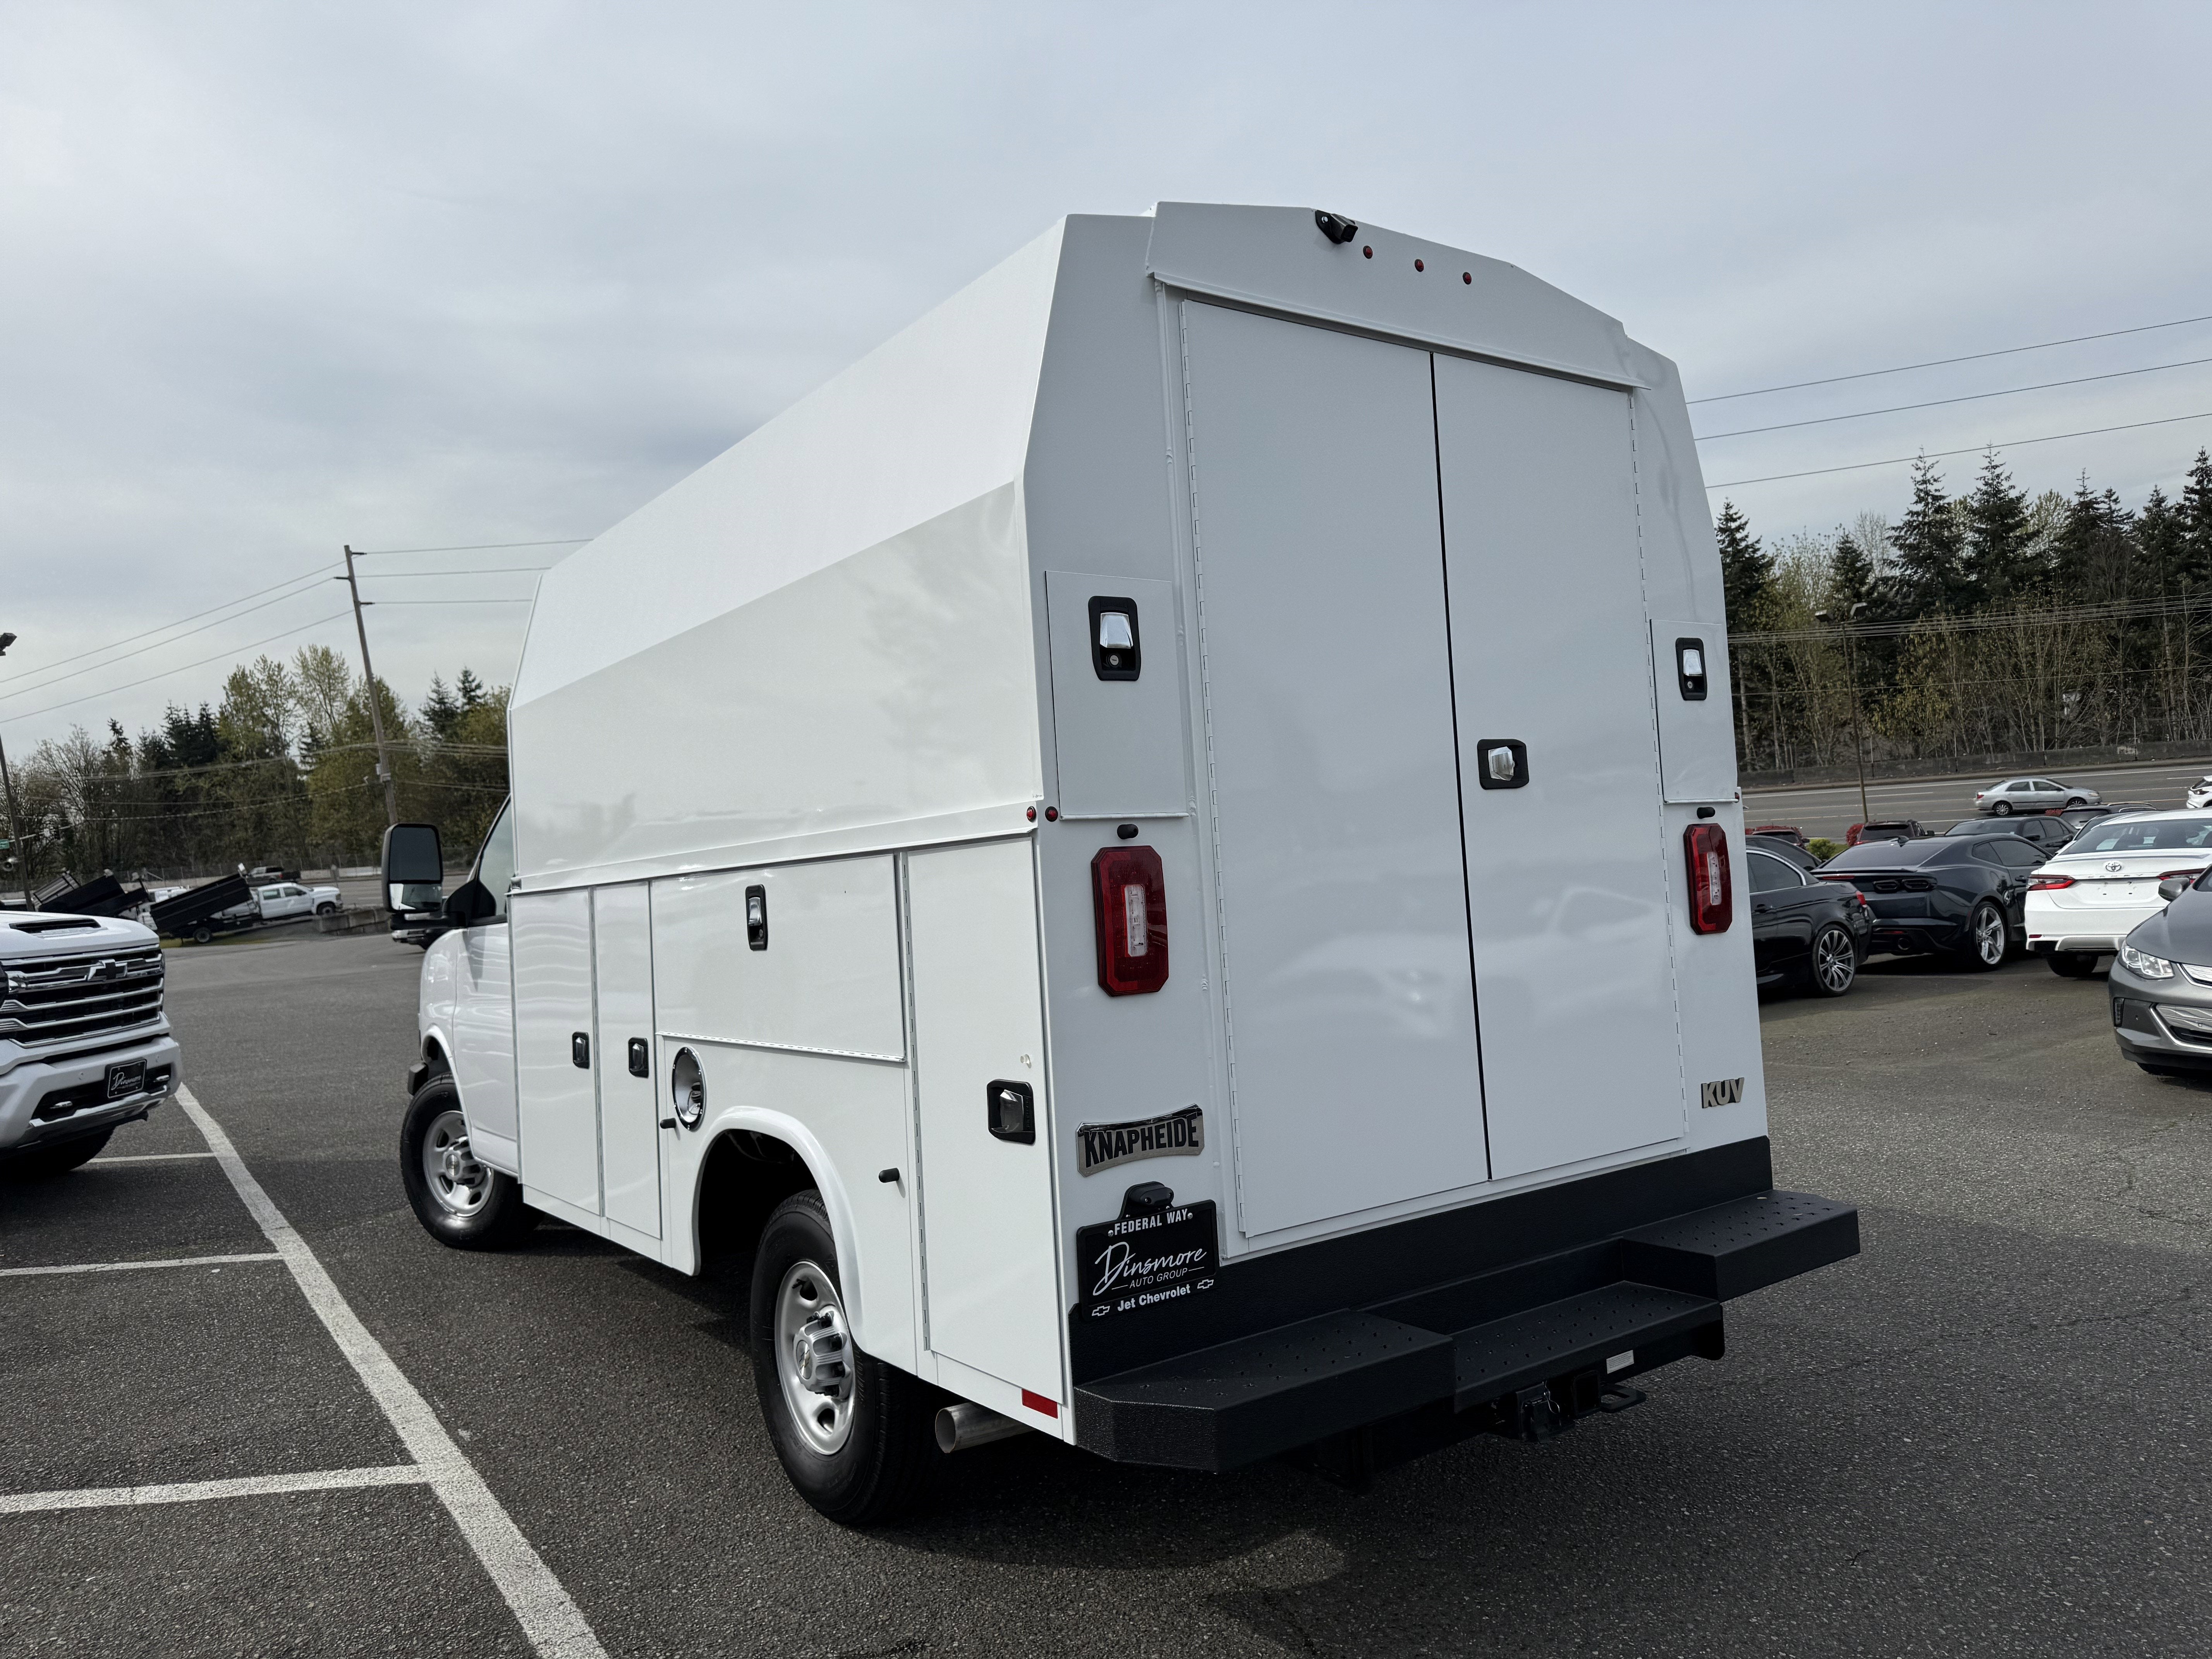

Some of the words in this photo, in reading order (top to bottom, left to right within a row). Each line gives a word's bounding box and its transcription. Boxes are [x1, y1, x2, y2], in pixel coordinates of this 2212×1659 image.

[1701, 1077, 1745, 1109] KUV
[1085, 1112, 1199, 1168] KNAPHEIDE
[1114, 1215, 1162, 1235] FEDERAL
[1166, 1208, 1188, 1224] WAY
[1092, 1242, 1207, 1296] Dinsmore
[1129, 1276, 1154, 1289] AUTO
[1156, 1267, 1188, 1282] GROUP
[1117, 1298, 1136, 1311] Jet
[1139, 1284, 1191, 1306] Chevrolet
